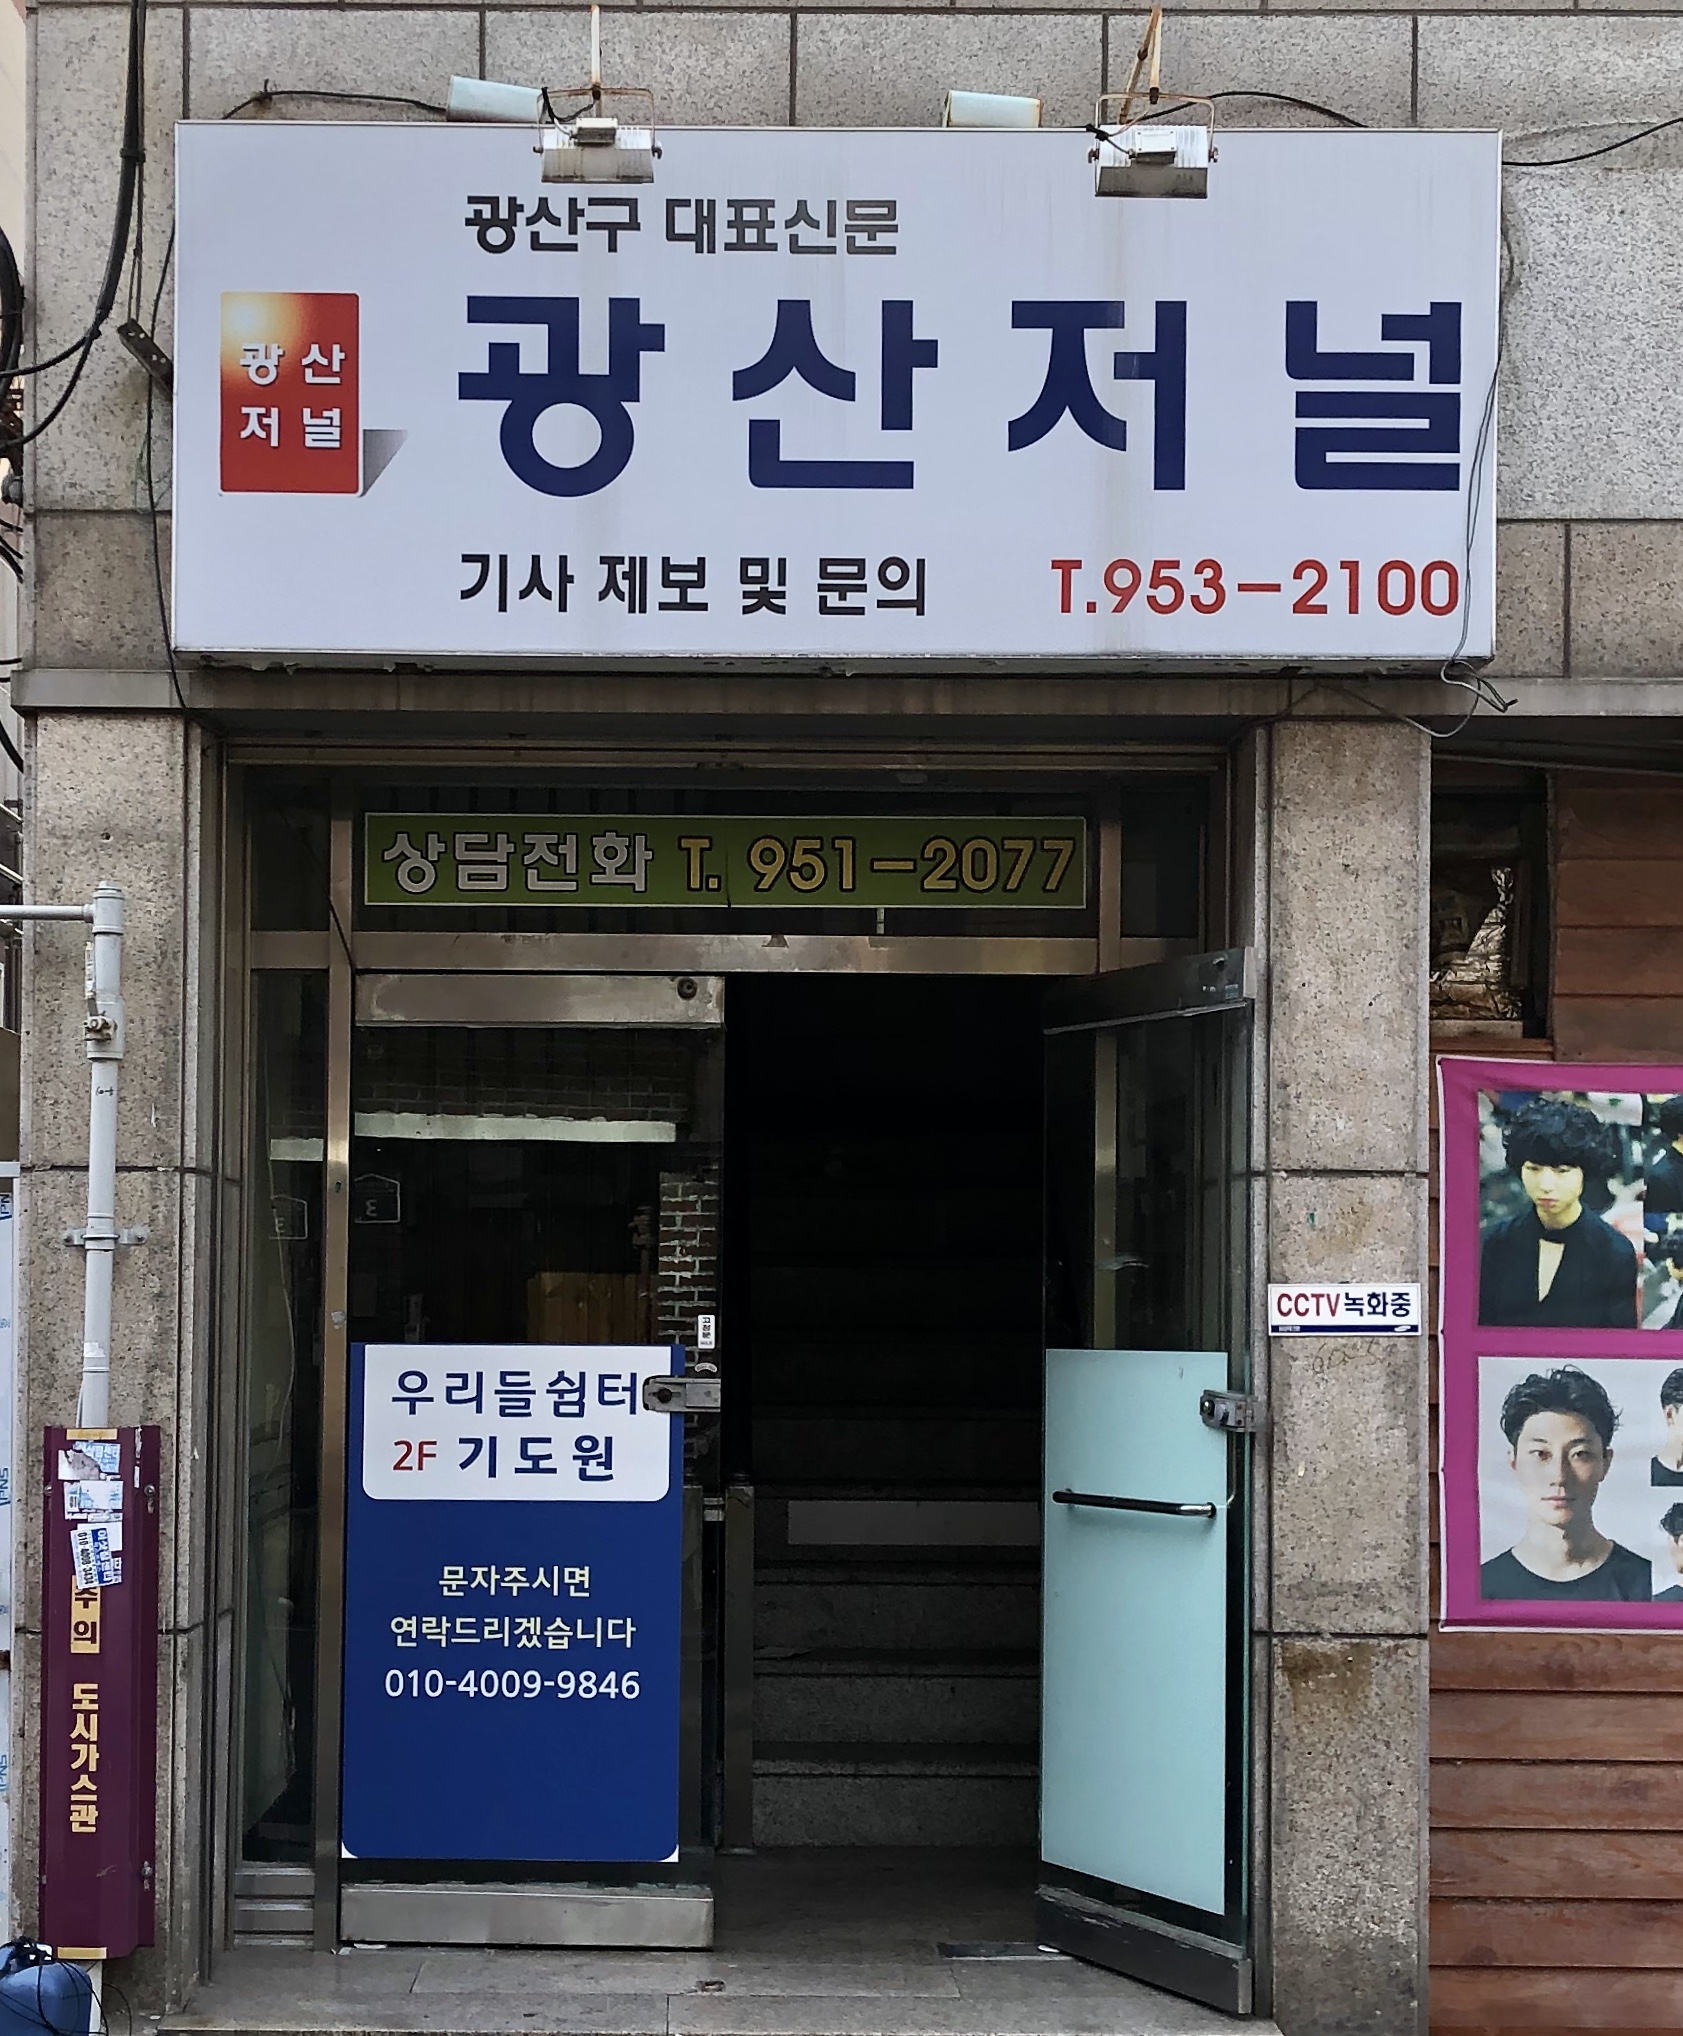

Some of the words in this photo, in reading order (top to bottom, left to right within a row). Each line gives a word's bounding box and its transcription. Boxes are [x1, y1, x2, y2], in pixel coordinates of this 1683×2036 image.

[464, 195, 641, 254] 광산구
[665, 198, 899, 255] 대표신문
[239, 343, 347, 386] 광산
[458, 295, 1462, 498] 광산저널
[239, 405, 343, 449] 저널
[460, 553, 575, 613] 기사
[598, 555, 709, 614] 제보
[739, 556, 787, 616] 및
[816, 556, 926, 617] 문의
[382, 830, 654, 894] 상담전화
[747, 835, 1077, 894] 951-2077
[391, 1370, 638, 1418] 우리들쉼터
[392, 1440, 438, 1472] 2F
[458, 1434, 615, 1482] 기도원
[438, 1565, 590, 1597] 문자주시면
[74, 1586, 98, 1645] 주의
[390, 1615, 637, 1650] 연락드리겠습니다
[385, 1669, 640, 1699] 010-4009-9846
[70, 1683, 100, 1833] 도시가스관
